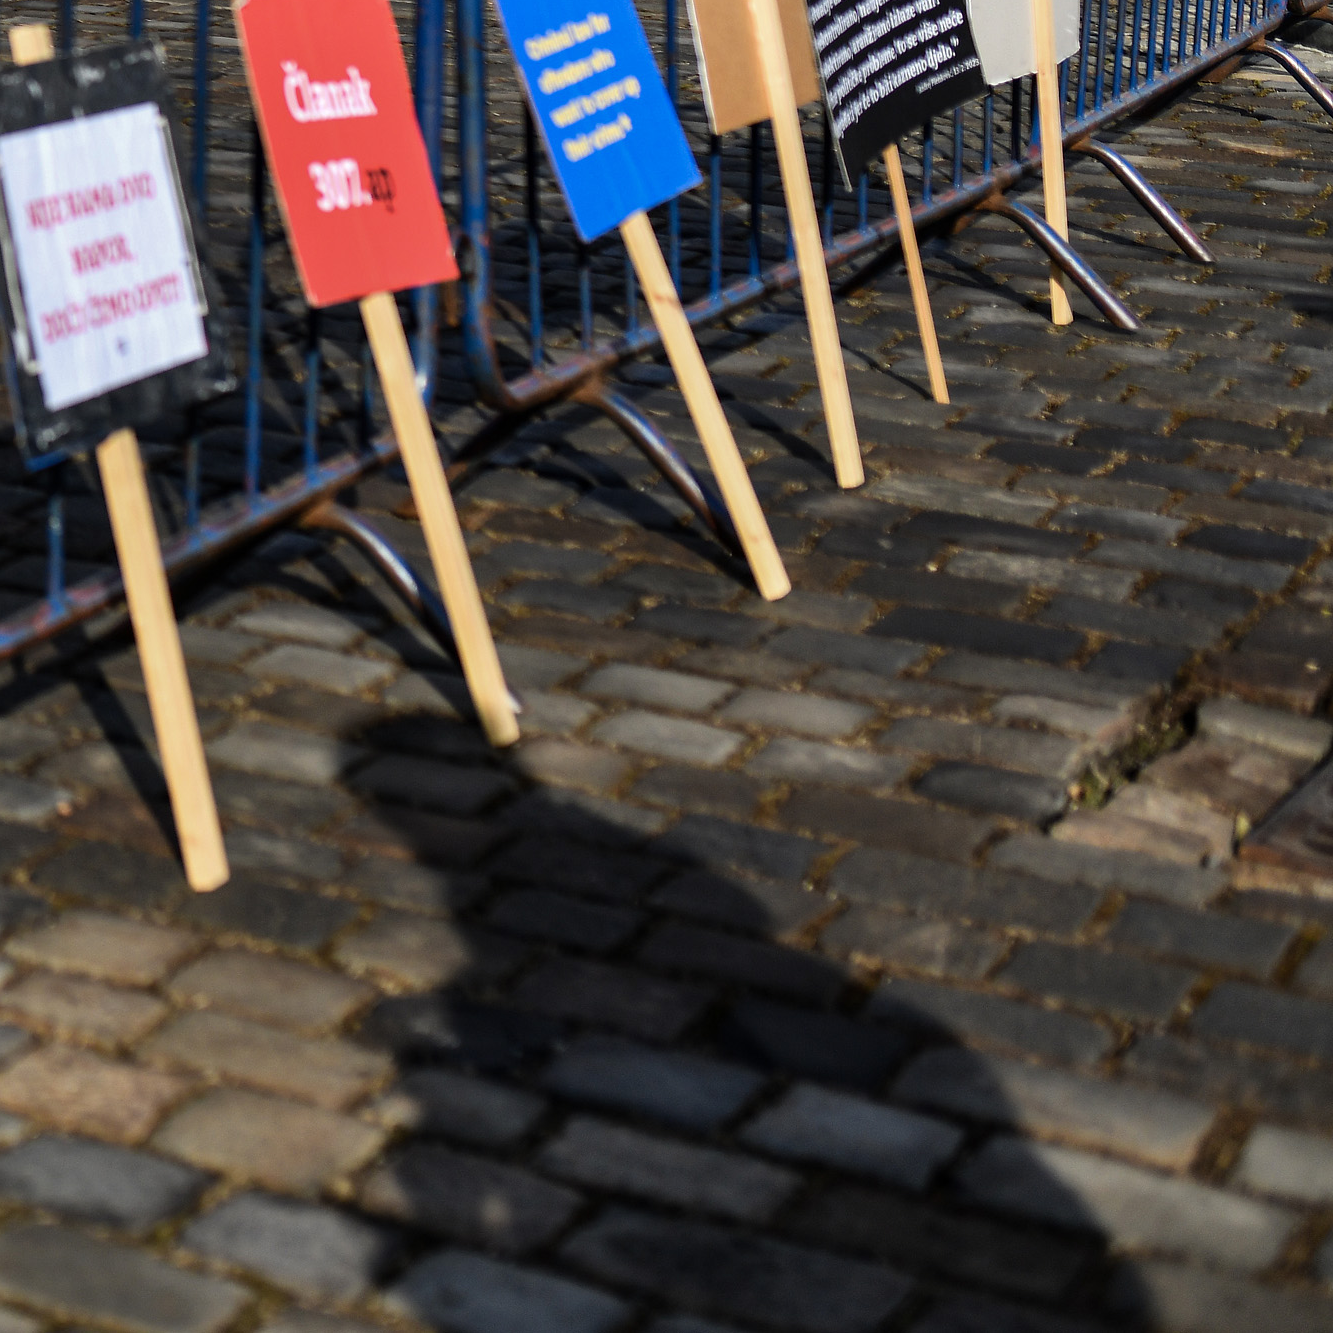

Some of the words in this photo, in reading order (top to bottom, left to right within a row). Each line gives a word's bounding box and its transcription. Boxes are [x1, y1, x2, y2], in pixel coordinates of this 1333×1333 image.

[907, 32, 918, 48] se
[917, 19, 939, 43] više
[937, 6, 964, 33] neće
[280, 60, 379, 124] Članak
